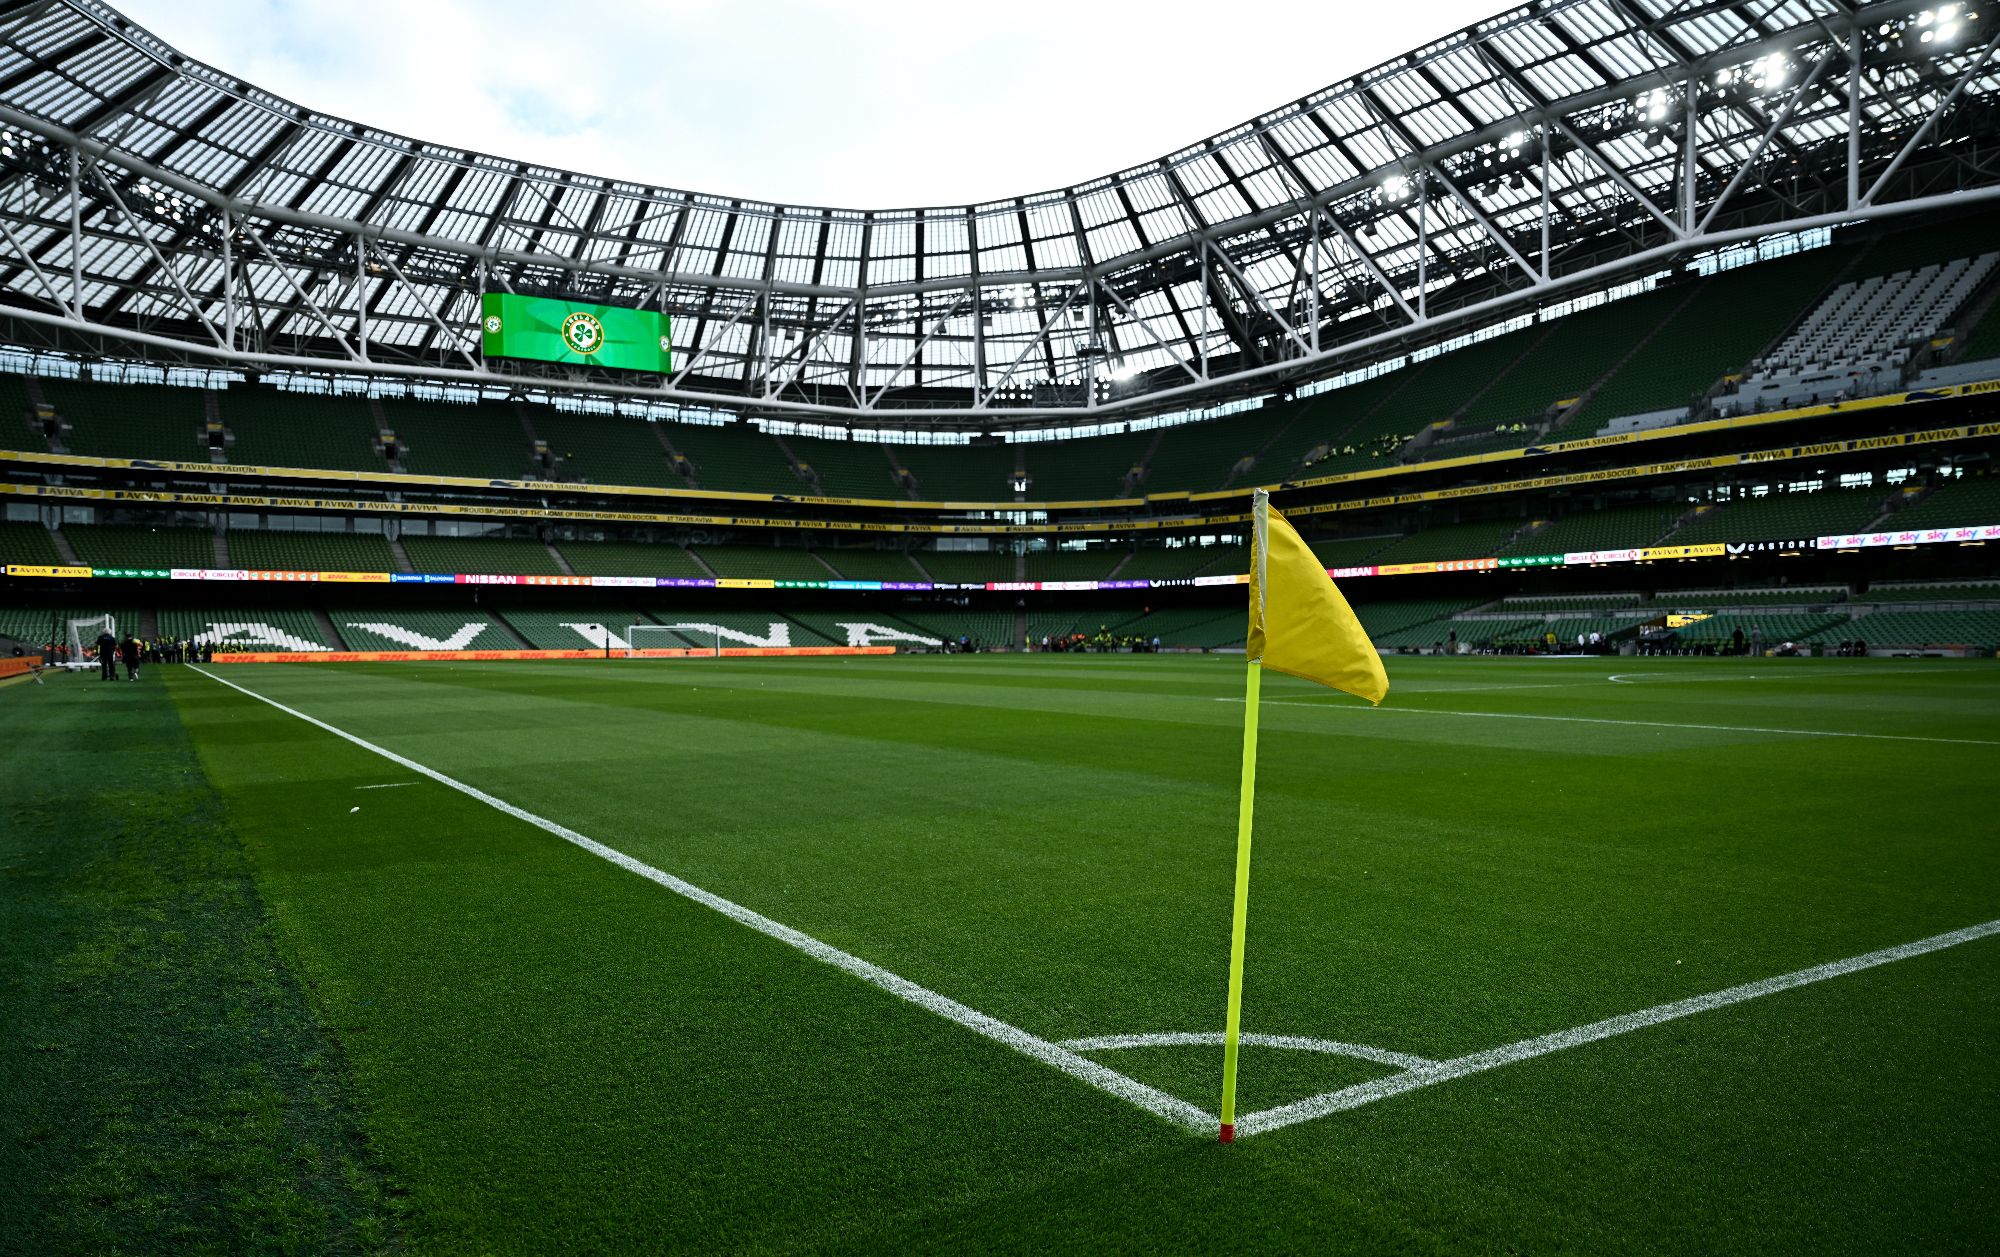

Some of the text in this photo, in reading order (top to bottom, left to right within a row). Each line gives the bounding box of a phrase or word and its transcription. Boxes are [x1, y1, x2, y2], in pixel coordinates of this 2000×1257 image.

[1917, 430, 1960, 441] AVIVA
[1566, 435, 1628, 449] AVIVA STADIUM
[1859, 437, 1898, 448] AVIVA
[1804, 444, 1840, 454] AVIVA
[1750, 450, 1786, 462] AVIVA
[216, 465, 257, 473] STADIUM
[1686, 460, 1712, 469] AVIVA
[1566, 474, 1588, 483] RUGBY
[1590, 472, 1606, 480] AND
[50, 488, 84, 496] AVIVA
[232, 496, 264, 504] AVIVA
[1371, 497, 1390, 505] AVIVA
[1401, 494, 1422, 502] AVIVA
[324, 500, 354, 508] AVIVA
[368, 502, 396, 510] AVIVA
[410, 504, 438, 512] AVIVA
[1872, 533, 1892, 545] sky
[1900, 531, 1920, 544] sky
[1928, 529, 1948, 542] sky
[1956, 528, 1978, 540] sky
[1821, 536, 1840, 547] sky
[1846, 534, 1866, 546] sky
[1748, 540, 1815, 551] CASTORE
[1652, 548, 1678, 556] AVIVA
[1334, 567, 1372, 578] NISSAN
[466, 575, 516, 584] NISSAN
[994, 582, 1035, 590] NISSAN
